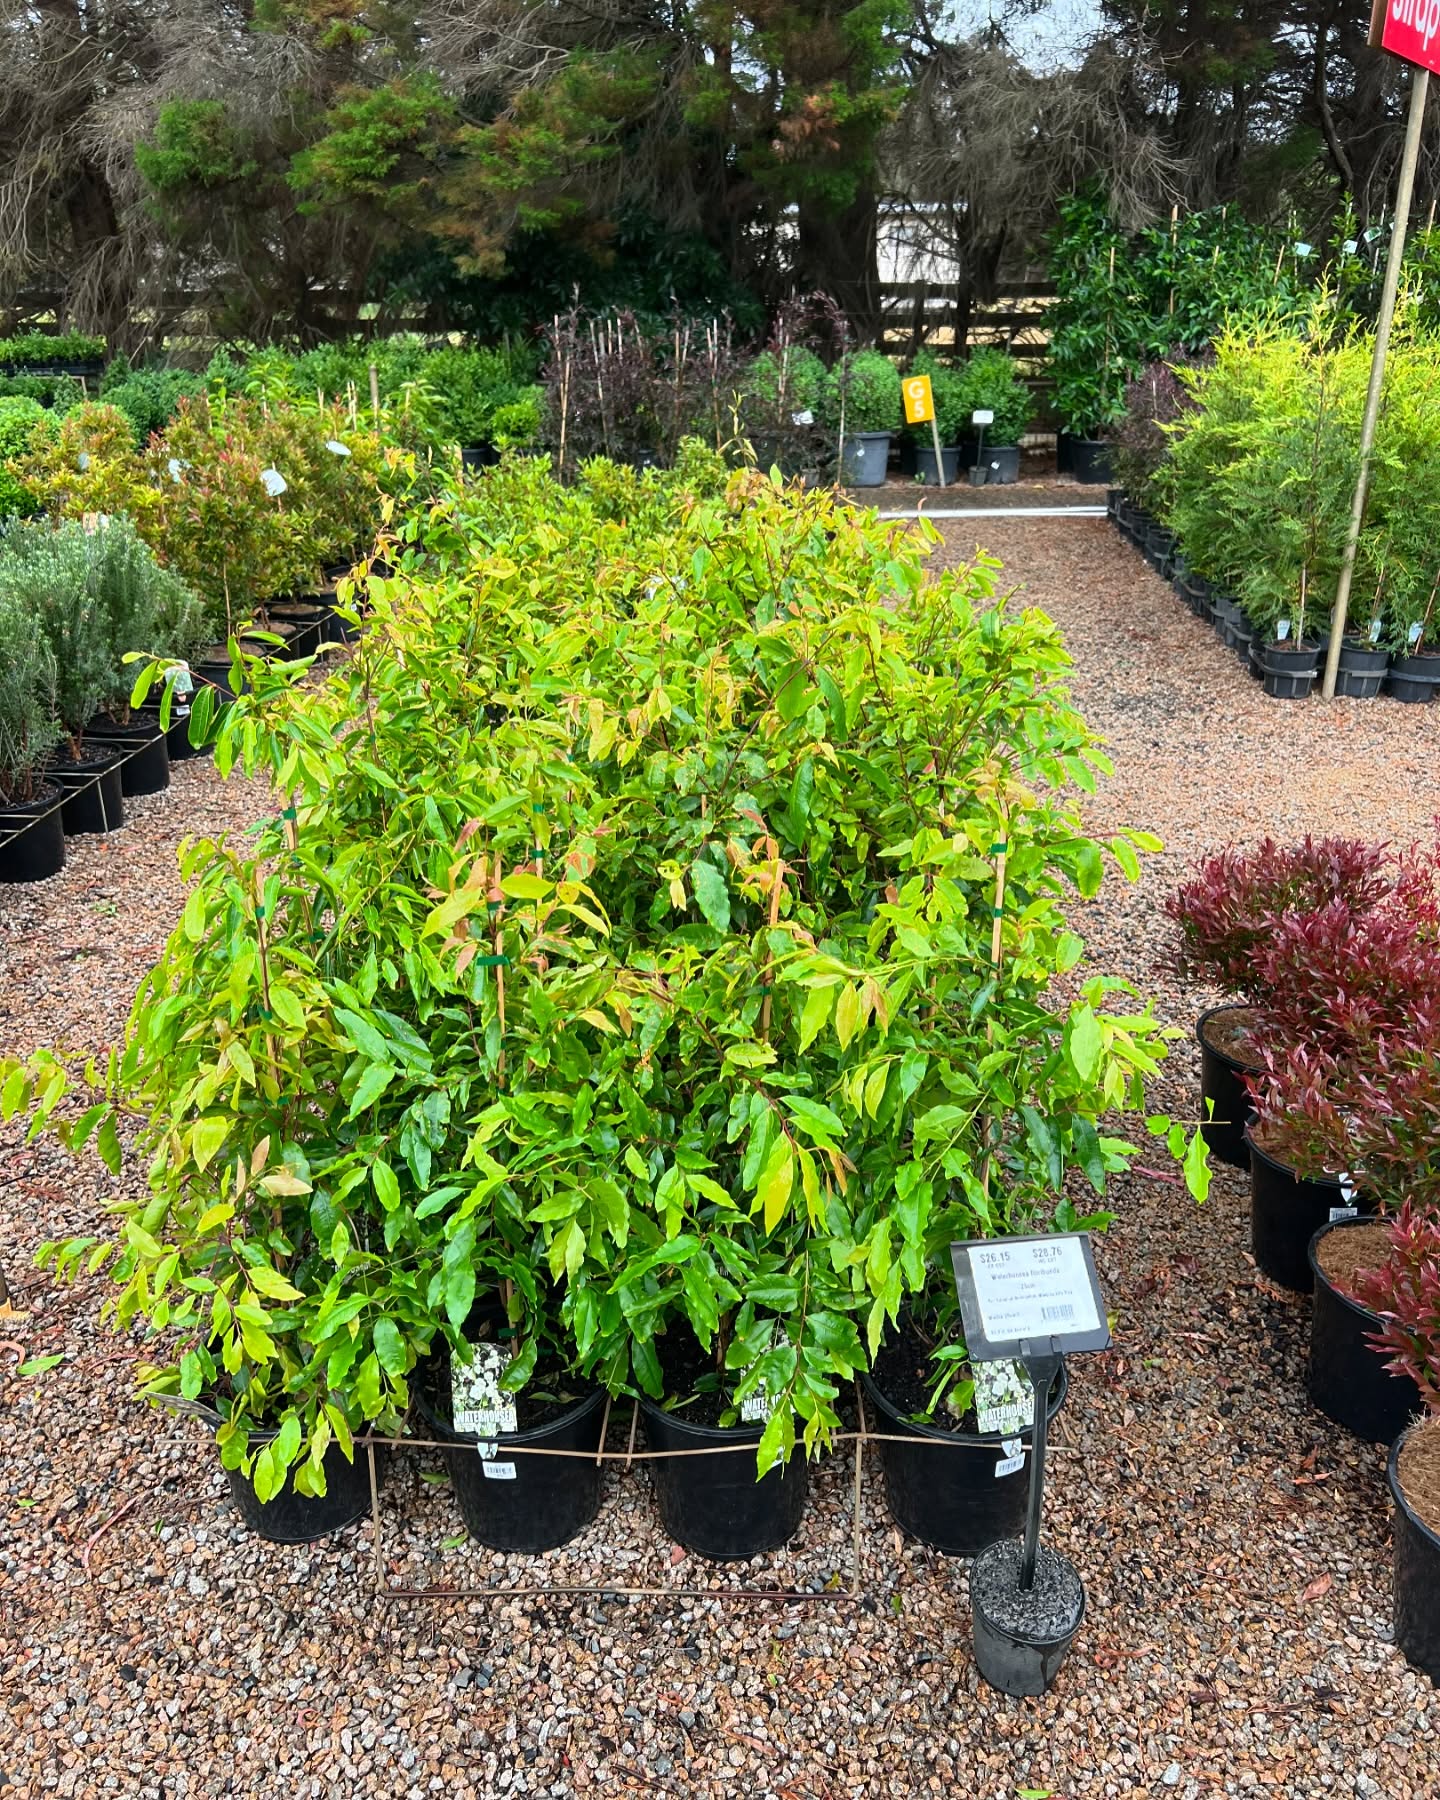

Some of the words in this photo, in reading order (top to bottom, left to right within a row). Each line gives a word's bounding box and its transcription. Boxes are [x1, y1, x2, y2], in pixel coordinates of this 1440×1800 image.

[908, 381, 925, 399] G
[914, 400, 925, 418] 5
[980, 1251, 1011, 1264] $26.15
[1032, 1246, 1063, 1258] $28.76
[980, 1402, 1034, 1422] WATERHOUSE
